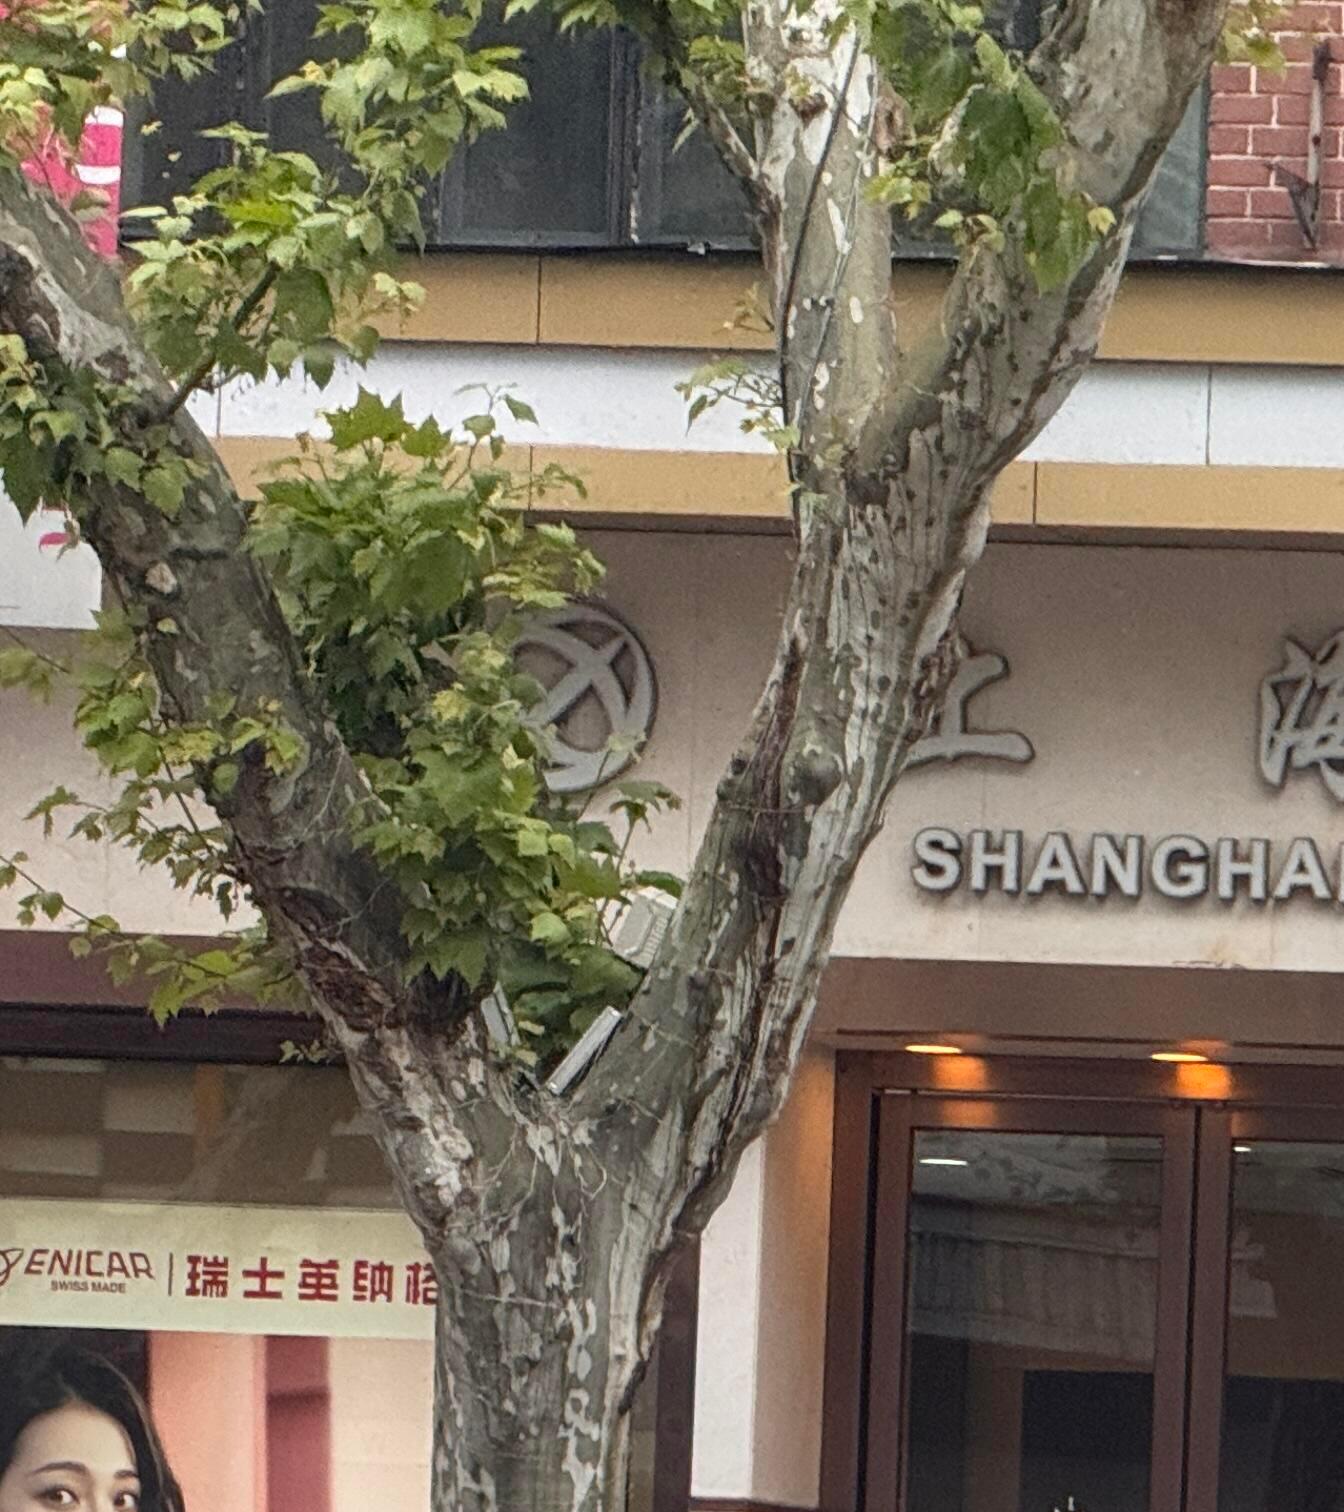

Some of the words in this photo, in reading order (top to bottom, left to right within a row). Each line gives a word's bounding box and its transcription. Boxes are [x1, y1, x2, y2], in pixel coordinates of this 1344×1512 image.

[24, 1248, 156, 1280] ENICAR
[51, 1280, 89, 1293] SWISS
[91, 1282, 127, 1294] MADE
